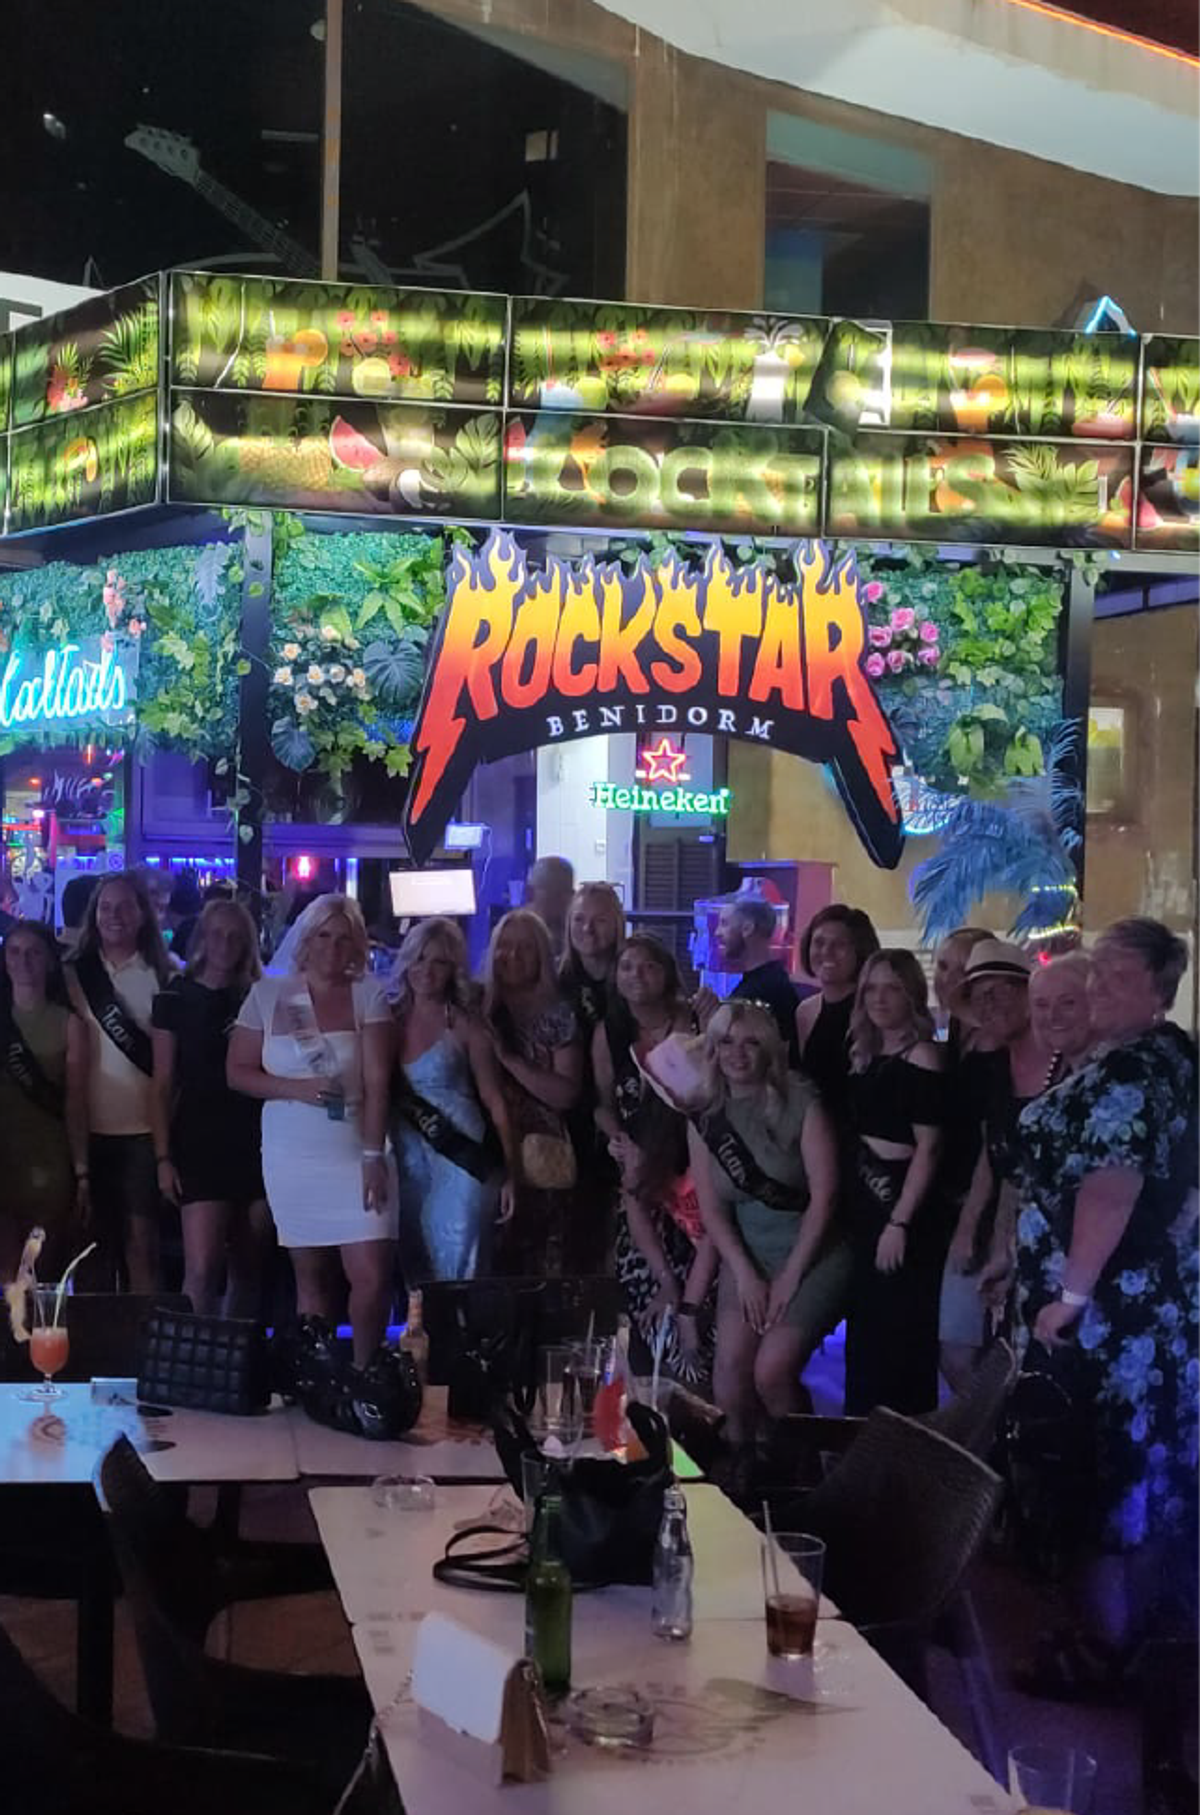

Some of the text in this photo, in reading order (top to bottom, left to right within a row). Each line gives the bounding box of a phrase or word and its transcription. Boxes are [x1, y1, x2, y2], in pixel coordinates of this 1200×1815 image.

[411, 538, 898, 822] ROCKSTAR
[547, 704, 775, 740] BENIDORM
[591, 782, 730, 815] Heineken
